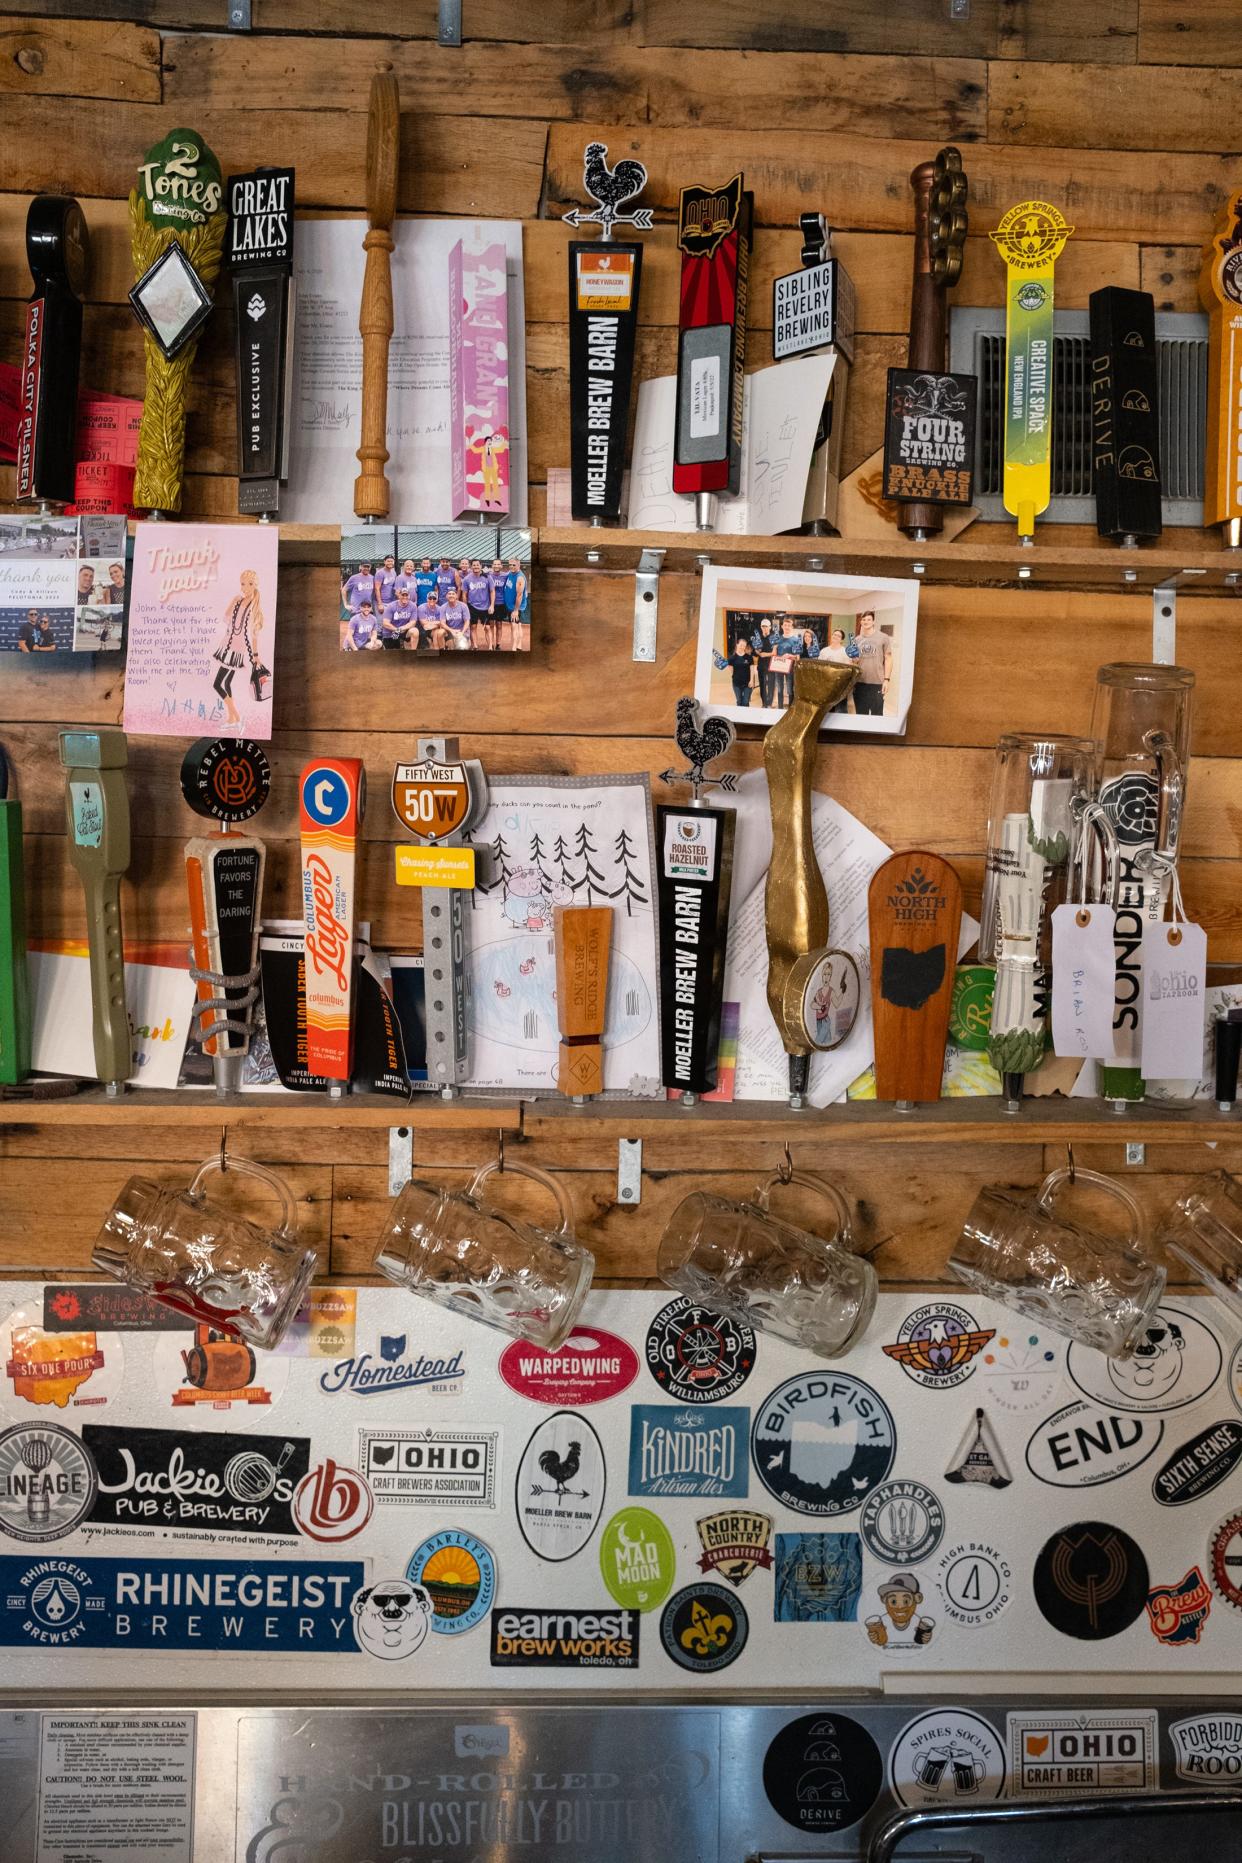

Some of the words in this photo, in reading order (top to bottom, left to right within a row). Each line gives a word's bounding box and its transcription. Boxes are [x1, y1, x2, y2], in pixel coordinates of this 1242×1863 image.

[165, 142, 200, 178] 2
[137, 163, 222, 213] Tones
[232, 176, 290, 216] GREAT
[687, 196, 729, 225] OHIO
[1000, 203, 1030, 230] YELLOW
[1032, 203, 1064, 227] SPRINGS
[232, 213, 288, 251] LAKES
[231, 251, 272, 262] BREWING
[1009, 254, 1052, 269] BREWERY
[778, 268, 830, 301] SIBLING
[778, 289, 830, 322] REVELRY
[736, 284, 747, 359] BREWING
[778, 311, 830, 342] BREWING
[27, 305, 41, 368] POLKA
[588, 317, 619, 371] BARN
[1014, 355, 1024, 372] NEW
[1029, 339, 1047, 394] CREATIVE
[24, 371, 38, 412] CITY
[251, 343, 260, 417] EXCLUSIVE
[1013, 374, 1023, 405] ENGLAND
[587, 377, 613, 429] BREW
[733, 366, 744, 447] COMPANY
[1012, 407, 1022, 420] IPA
[1028, 396, 1046, 434] SPACE
[1091, 355, 1115, 471] DERIVE
[251, 421, 260, 451] PUB
[902, 416, 966, 444] FOUR
[20, 417, 32, 493] PILSNER
[900, 440, 966, 462] STRING
[906, 458, 942, 467] BREWING
[79, 467, 108, 475] TICKET
[587, 433, 608, 505] MOELLER
[889, 464, 971, 484] BRASS
[888, 486, 932, 498] PALE
[937, 491, 969, 501] ALE
[889, 477, 969, 493] KNUCKLE
[148, 540, 220, 573] Thank
[46, 574, 71, 587] you
[135, 604, 157, 613] John
[142, 617, 168, 625] Thank
[171, 618, 187, 627] you
[155, 638, 187, 648] playing
[190, 637, 210, 645] with
[160, 647, 186, 655] Thank
[164, 658, 211, 669] celebrating
[199, 742, 226, 788] REBEL
[235, 738, 271, 786] METTLE
[405, 769, 428, 780] FIFTY
[430, 770, 455, 781] WEST
[315, 779, 333, 816] C
[211, 805, 257, 822] BREWERY
[217, 855, 255, 867] FORTUNE
[669, 853, 709, 866] HAZELNUT
[671, 843, 707, 855] ROASTED
[220, 871, 251, 883] FAVORS
[228, 890, 244, 900] THE
[303, 870, 315, 932] COLUMBUS
[886, 896, 947, 908] NORTH
[219, 906, 251, 918] DARING
[306, 853, 349, 992] Lager
[676, 886, 702, 944] BARN
[895, 908, 938, 921] HIGH
[588, 927, 599, 977] WOLF'S
[1113, 856, 1145, 1031] SONDER
[574, 945, 584, 1006] BREWING
[676, 949, 698, 1003] BREW
[1162, 970, 1198, 991] ohio
[308, 993, 345, 1007] columbus
[587, 981, 598, 1021] RIDGE
[313, 1052, 342, 1062] COLUMBUS
[387, 1039, 398, 1070] TIGER
[675, 1007, 695, 1081] MOELLER
[310, 1302, 354, 1312] BUZZSAW
[901, 1307, 932, 1337] YELLOW
[935, 1306, 972, 1328] SPRINGS
[309, 1336, 353, 1345] BUZZSAW
[648, 1336, 660, 1364] OLD
[21, 1365, 38, 1376] SIX
[42, 1363, 61, 1374] ONE
[64, 1359, 90, 1372] POUR
[320, 1350, 466, 1393] Homestead
[922, 1371, 967, 1386] BREWERY
[667, 1372, 746, 1402] WILLIAMSBURG
[765, 1381, 885, 1439] BIRDFISH
[1050, 1405, 1081, 1427] ENDEAVOR
[1047, 1415, 1143, 1471] END
[405, 1447, 480, 1469] OHIO
[1159, 1454, 1200, 1494] SIXTH
[1194, 1425, 1238, 1464] SENSE
[98, 1447, 226, 1502] Jackie
[372, 1477, 396, 1490] CRAFT
[397, 1479, 433, 1491] BREWERS
[434, 1480, 481, 1492] ASSOCIATION
[648, 1476, 697, 1494] Artisan
[1188, 1467, 1221, 1494] BREWING
[116, 1498, 159, 1516] PUB
[163, 1499, 176, 1519] &
[179, 1501, 271, 1524] BREWERY
[525, 1507, 553, 1518] MOELLER
[554, 1509, 573, 1519] BREW
[574, 1510, 593, 1521] BARN
[781, 1491, 841, 1512] BREWING
[864, 1483, 942, 1527] TAPHANDLES
[80, 1526, 155, 1538] www.jackieos.com
[172, 1531, 217, 1543] sustainably
[218, 1534, 248, 1544] crafted
[249, 1536, 266, 1545] with
[266, 1538, 299, 1548] purpose
[706, 1517, 764, 1535] NORTH
[426, 1533, 487, 1561] BARLEY'S
[708, 1532, 762, 1547] COUNTRY
[615, 1543, 657, 1568] MAD
[940, 1545, 965, 1568] HIGH
[969, 1542, 1000, 1561] BANK
[1000, 1562, 1012, 1579] CO
[20, 1561, 93, 1587] RHINEGEIST
[617, 1565, 661, 1585] MOON
[116, 1572, 351, 1608] RHINEGEIST
[85, 1600, 105, 1608] MADE
[986, 1594, 1009, 1621] OHIO
[1152, 1586, 1207, 1636] Brew
[22, 1621, 86, 1644] BREWERY
[116, 1615, 346, 1638] BREWERY
[498, 1610, 633, 1639] earnest
[497, 1634, 563, 1657] brew
[568, 1636, 632, 1657] works
[579, 1655, 615, 1667] toledo,
[618, 1655, 632, 1665] oh
[910, 1728, 952, 1750] SPIRES
[955, 1728, 992, 1759] SOCIAL
[1059, 1734, 1137, 1757] OHIO
[1027, 1768, 1063, 1784] CRAFT
[1067, 1767, 1094, 1783] BEER
[799, 1808, 842, 1820] DERIVE
